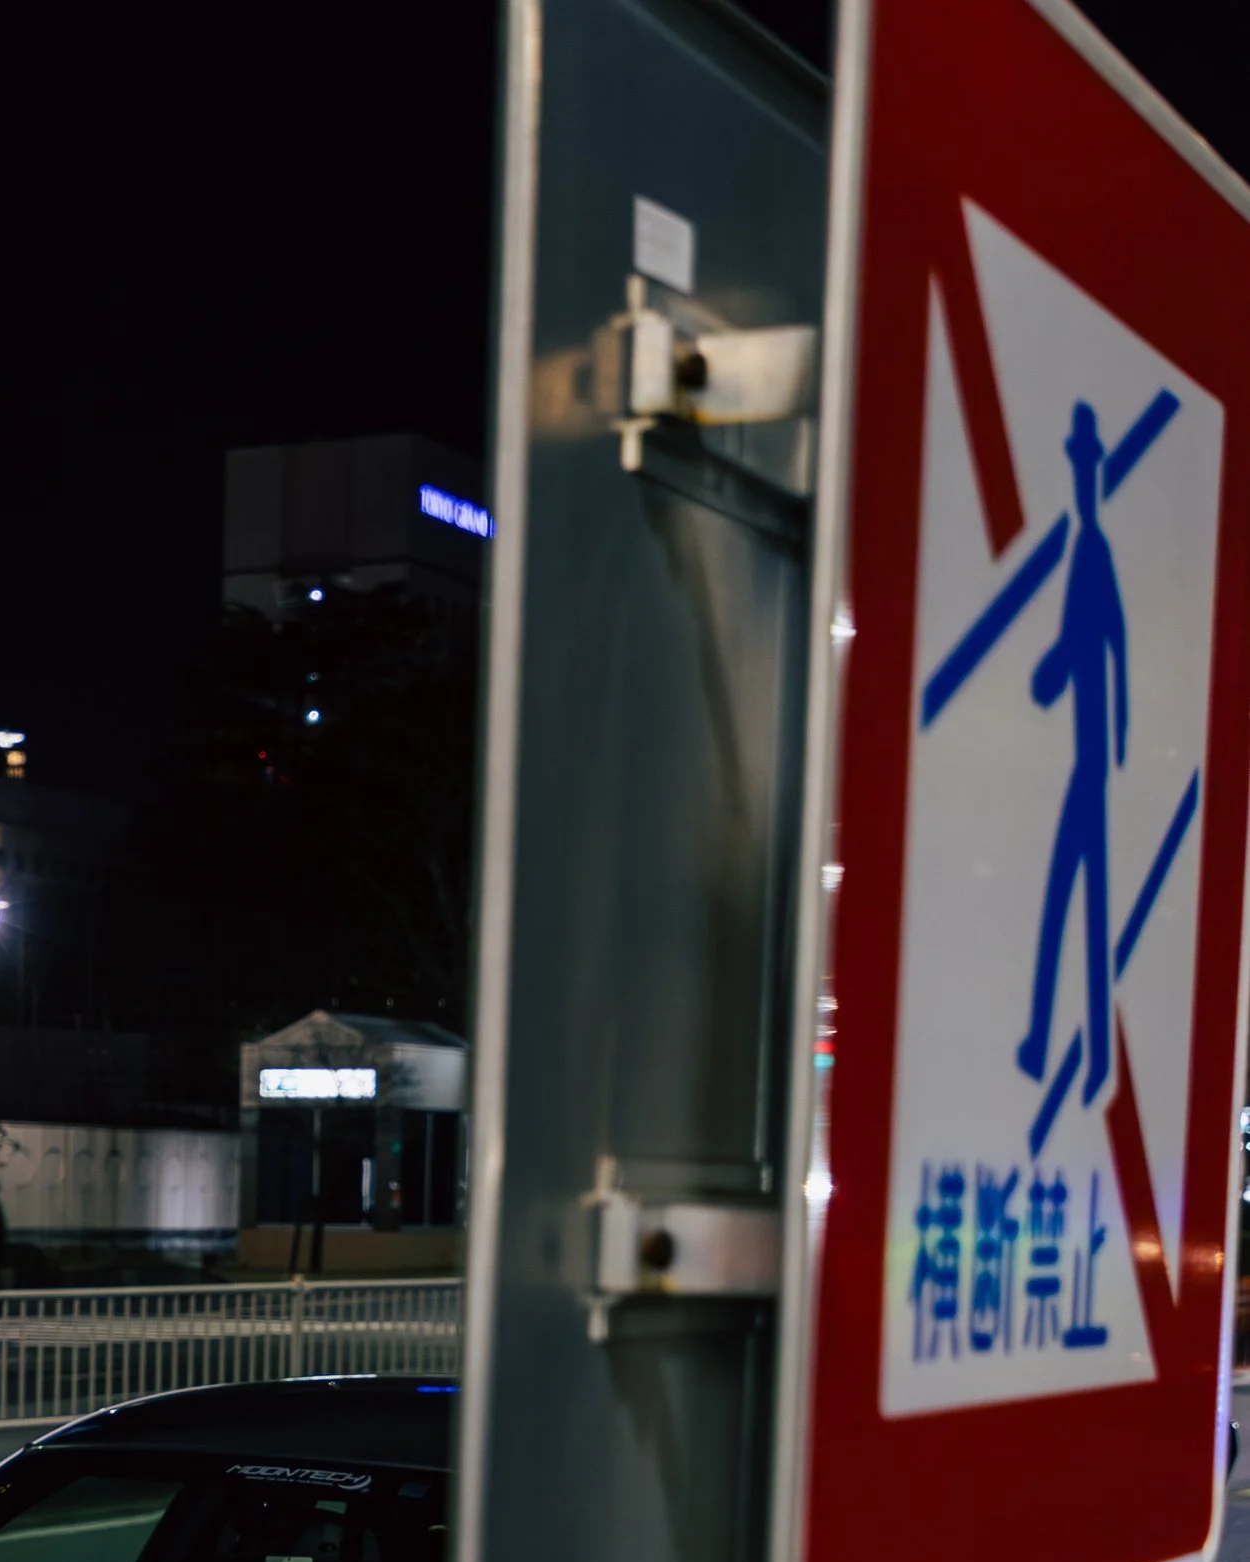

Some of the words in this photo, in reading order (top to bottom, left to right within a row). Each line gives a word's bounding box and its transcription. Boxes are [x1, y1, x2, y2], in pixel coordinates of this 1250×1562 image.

[908, 1159, 1108, 1364] 横断禁止
[225, 1464, 367, 1484] MOONTECH
